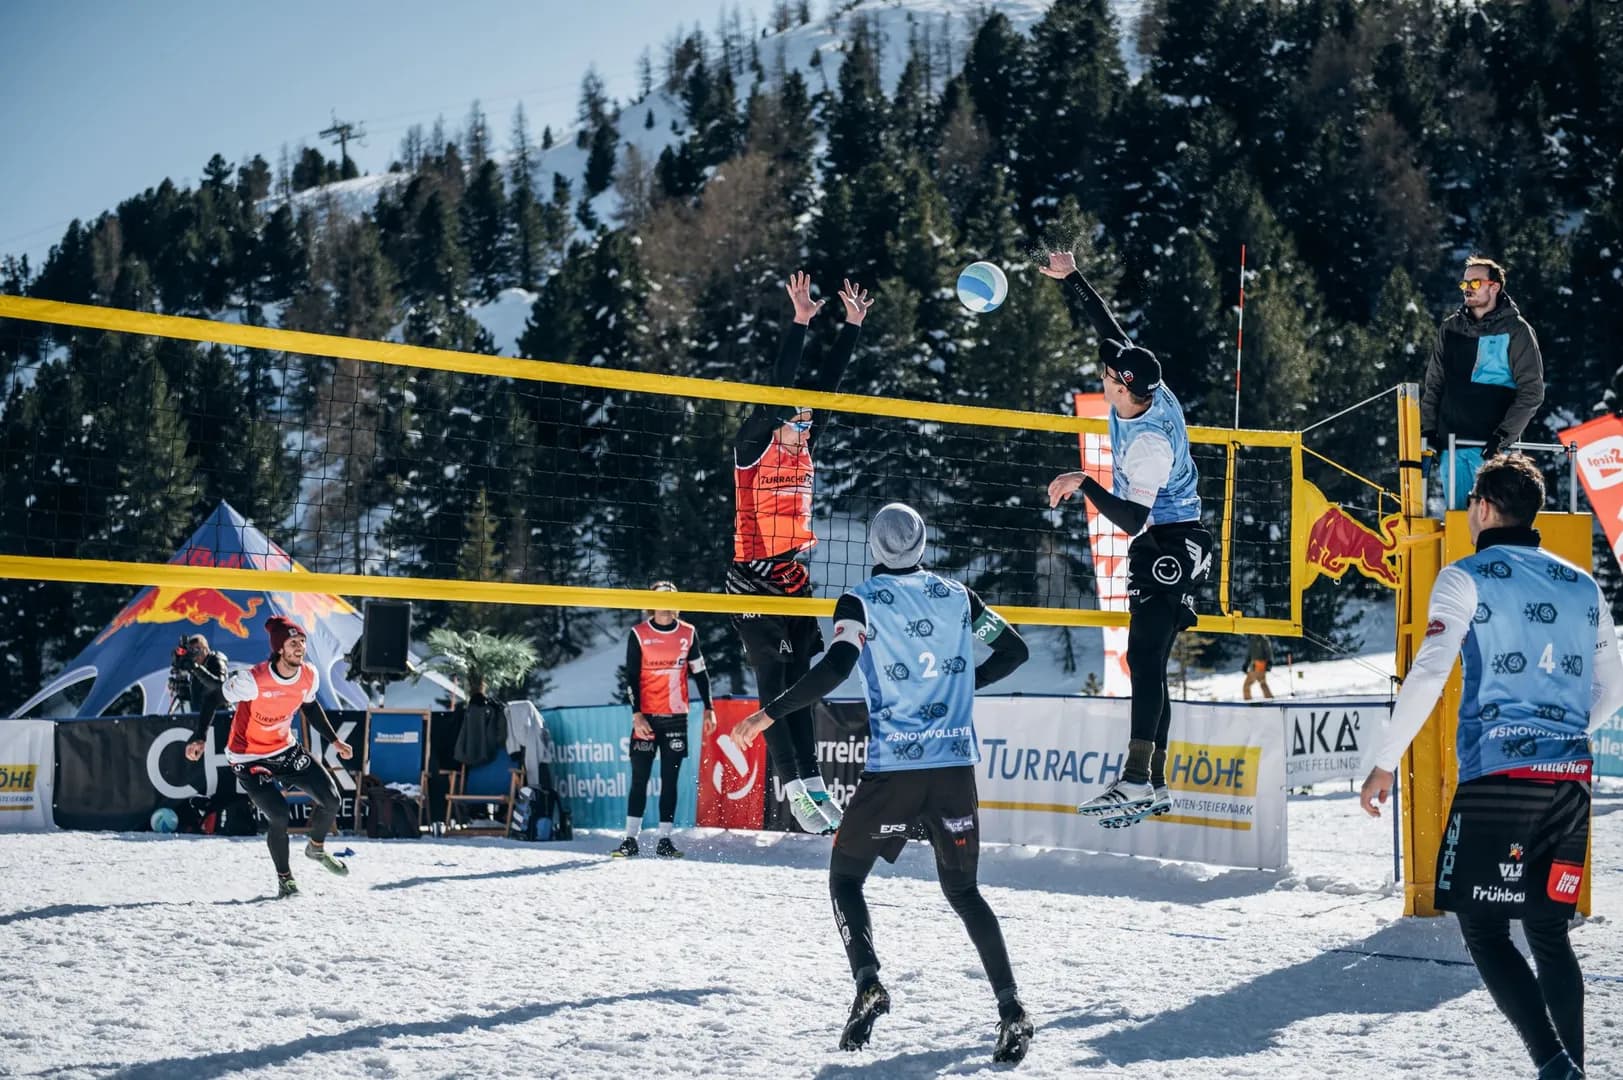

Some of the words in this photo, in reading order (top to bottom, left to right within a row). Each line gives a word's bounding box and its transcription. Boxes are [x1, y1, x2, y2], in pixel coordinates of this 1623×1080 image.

[680, 638, 689, 651] 2
[1536, 642, 1557, 675] 4
[918, 650, 938, 679] 2
[982, 738, 1124, 785] TURRACH
[1171, 750, 1246, 789] HÖHE
